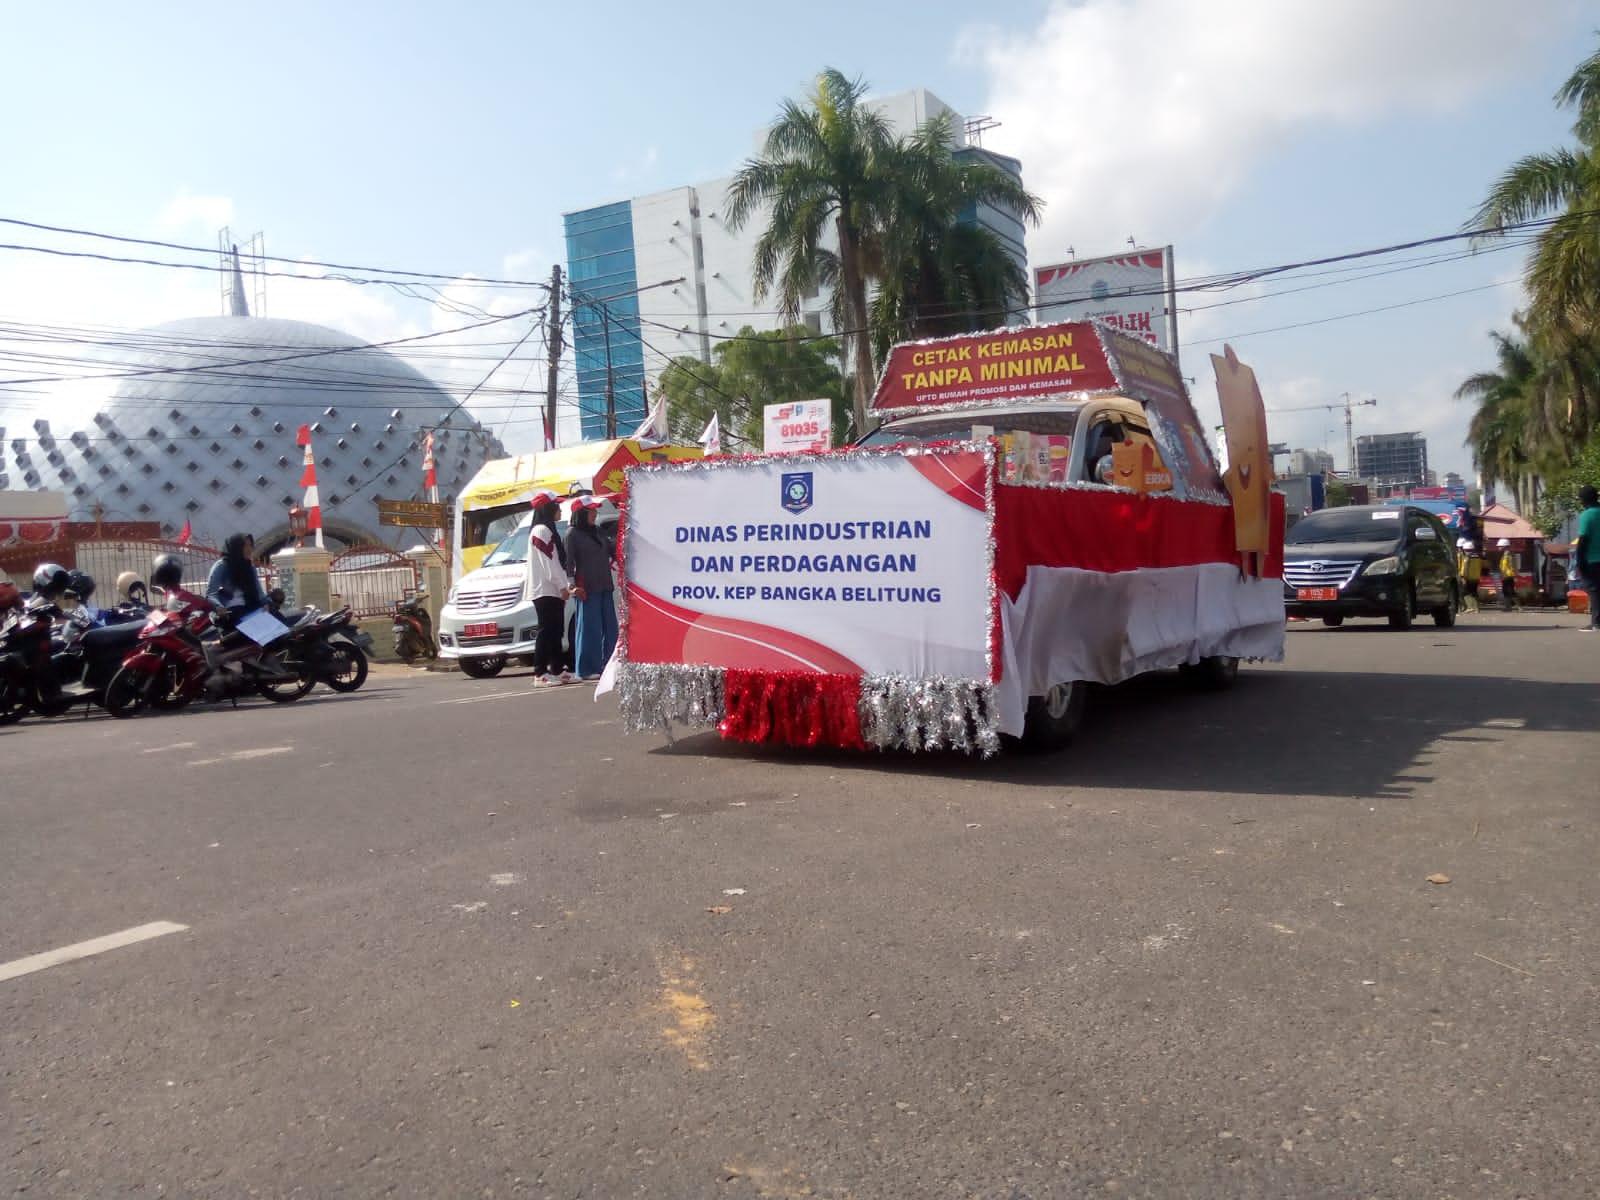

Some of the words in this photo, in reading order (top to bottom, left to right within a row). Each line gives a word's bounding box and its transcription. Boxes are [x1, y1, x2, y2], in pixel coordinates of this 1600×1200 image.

[912, 346, 972, 367] CETAK
[977, 332, 1073, 359] KEMASAN
[902, 369, 974, 391] TANPA
[980, 353, 1086, 382] MINIMAL
[915, 393, 937, 402] UPTD
[938, 390, 968, 401] RUMAH
[969, 385, 1007, 396] PROMOSI
[1009, 382, 1027, 391] DAN
[1028, 379, 1072, 390] KEMASAN
[675, 525, 738, 544] DINAS
[743, 520, 932, 542] PERINDUSTRIAN
[691, 556, 735, 573] DAN
[740, 554, 917, 573] PERDAGANGAN
[672, 585, 720, 600] PROV.
[724, 586, 757, 600] KEP
[761, 586, 837, 601] BANGKA
[842, 587, 941, 603] BELITUNG
